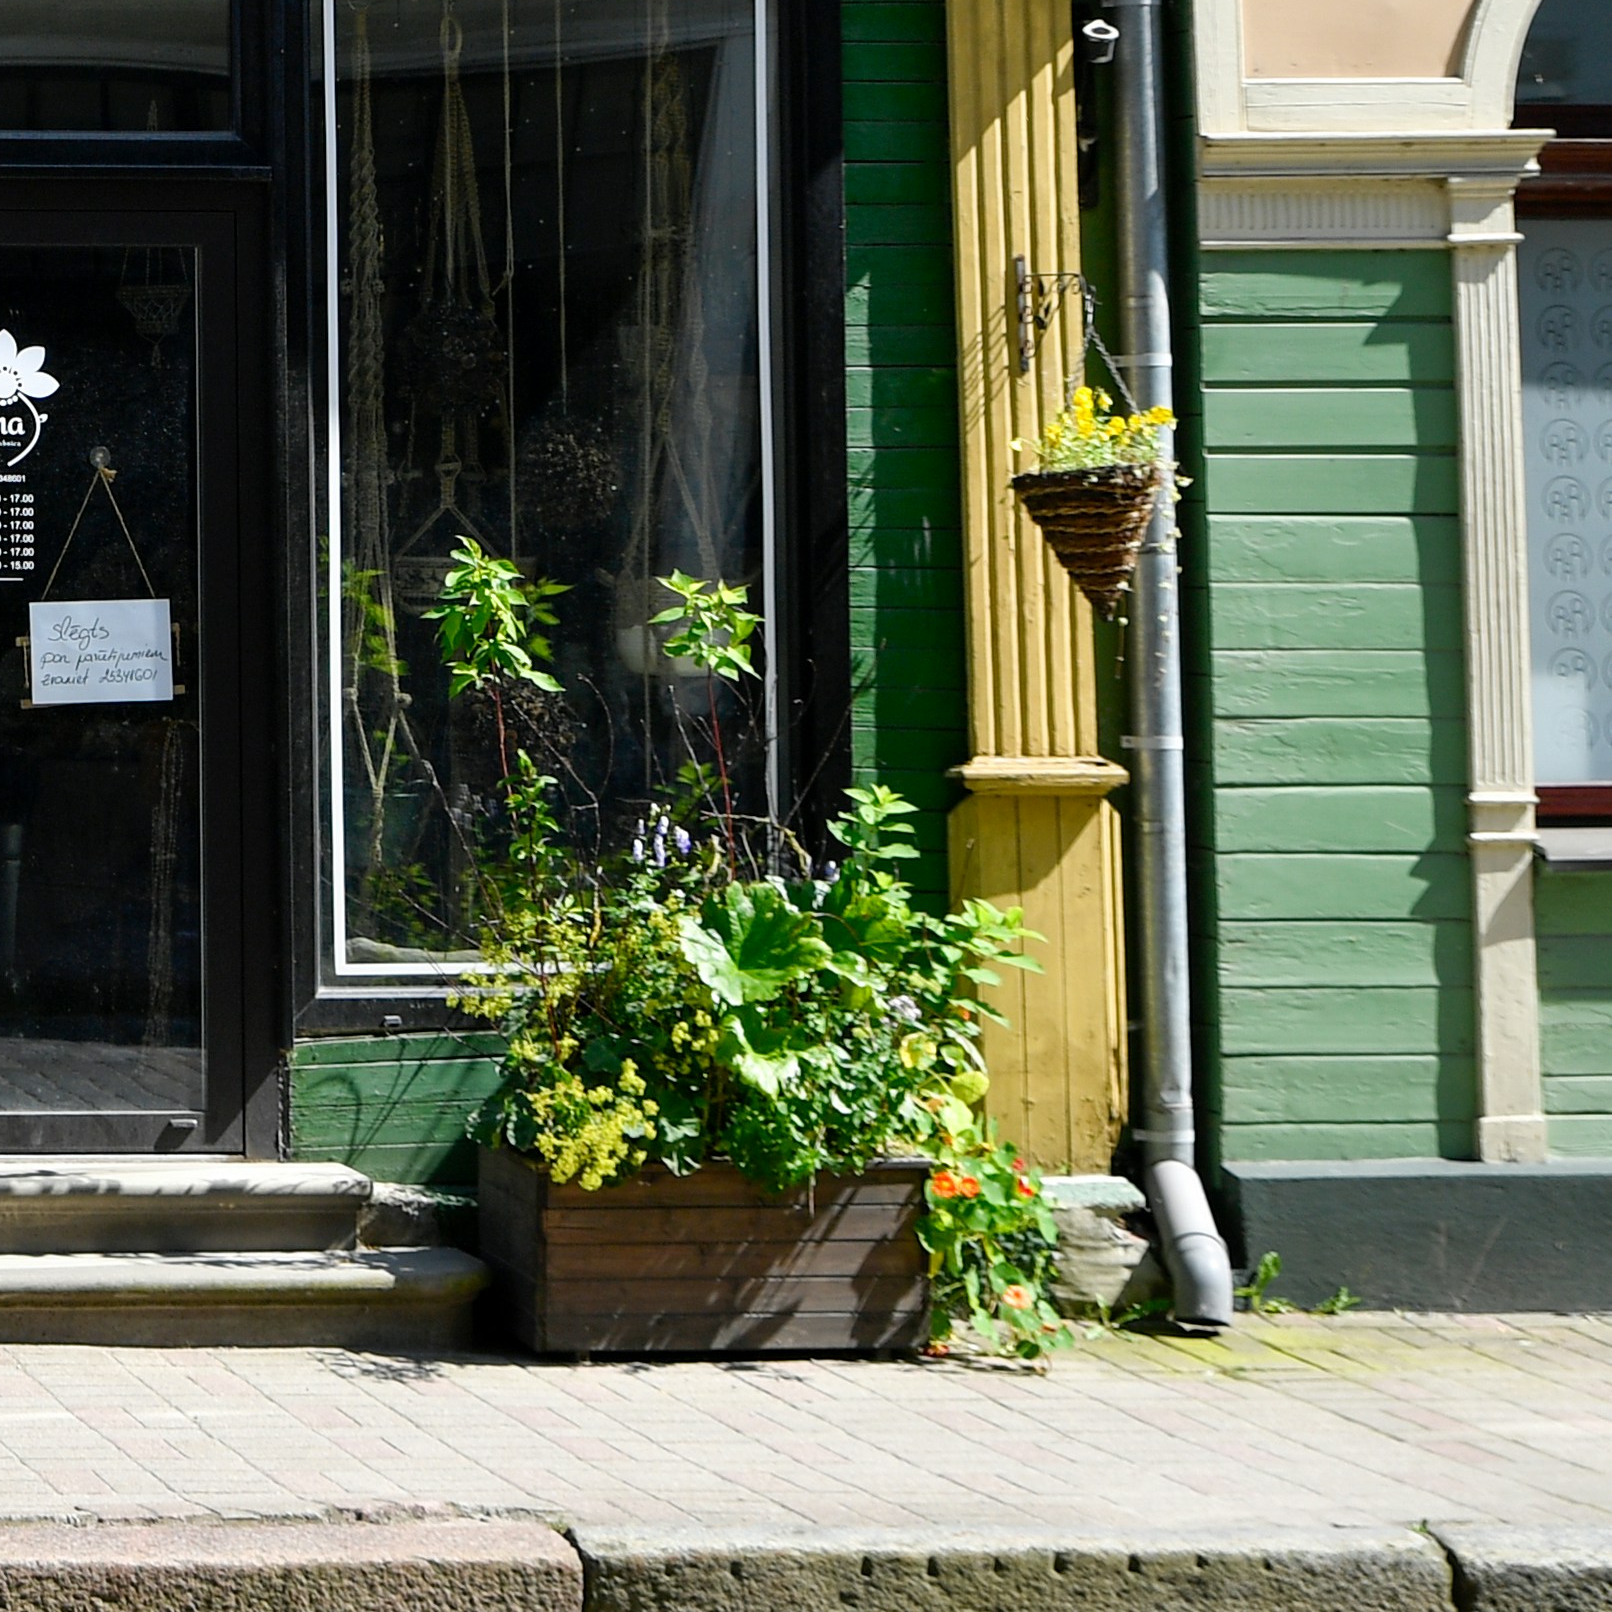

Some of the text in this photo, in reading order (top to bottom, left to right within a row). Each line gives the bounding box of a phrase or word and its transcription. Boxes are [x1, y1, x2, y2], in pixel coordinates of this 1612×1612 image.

[9, 494, 35, 503] 17.00
[9, 507, 35, 516] 17.00
[9, 521, 35, 530] 17.00
[9, 534, 35, 543] 17.00
[9, 547, 35, 556] 17.00
